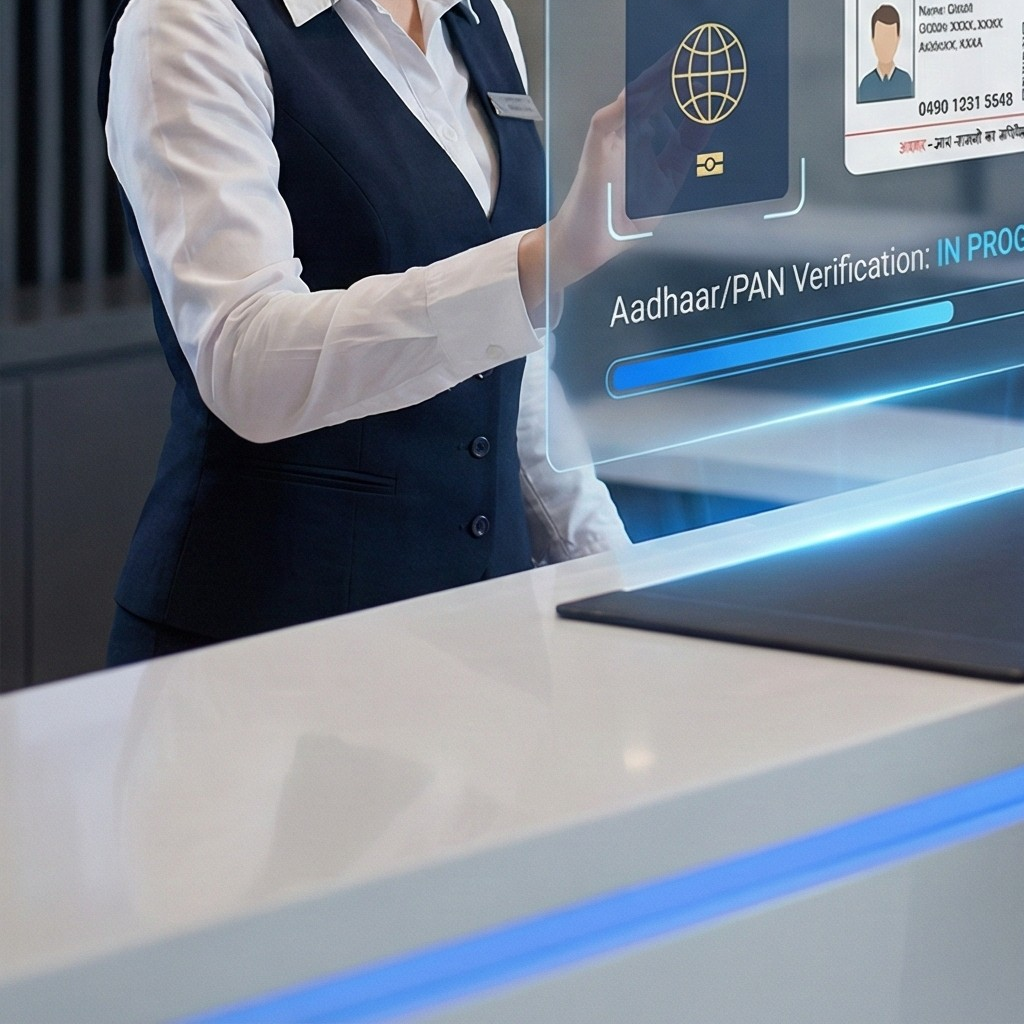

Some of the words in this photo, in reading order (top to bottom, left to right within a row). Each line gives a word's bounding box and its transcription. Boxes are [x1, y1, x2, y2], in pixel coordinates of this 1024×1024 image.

[918, 99, 949, 116] 0490
[952, 96, 980, 112] 1231
[984, 92, 1013, 108] 5548
[609, 266, 785, 328] Aadhaar/PAN
[792, 246, 930, 293] Verification:
[937, 236, 960, 267] IN
